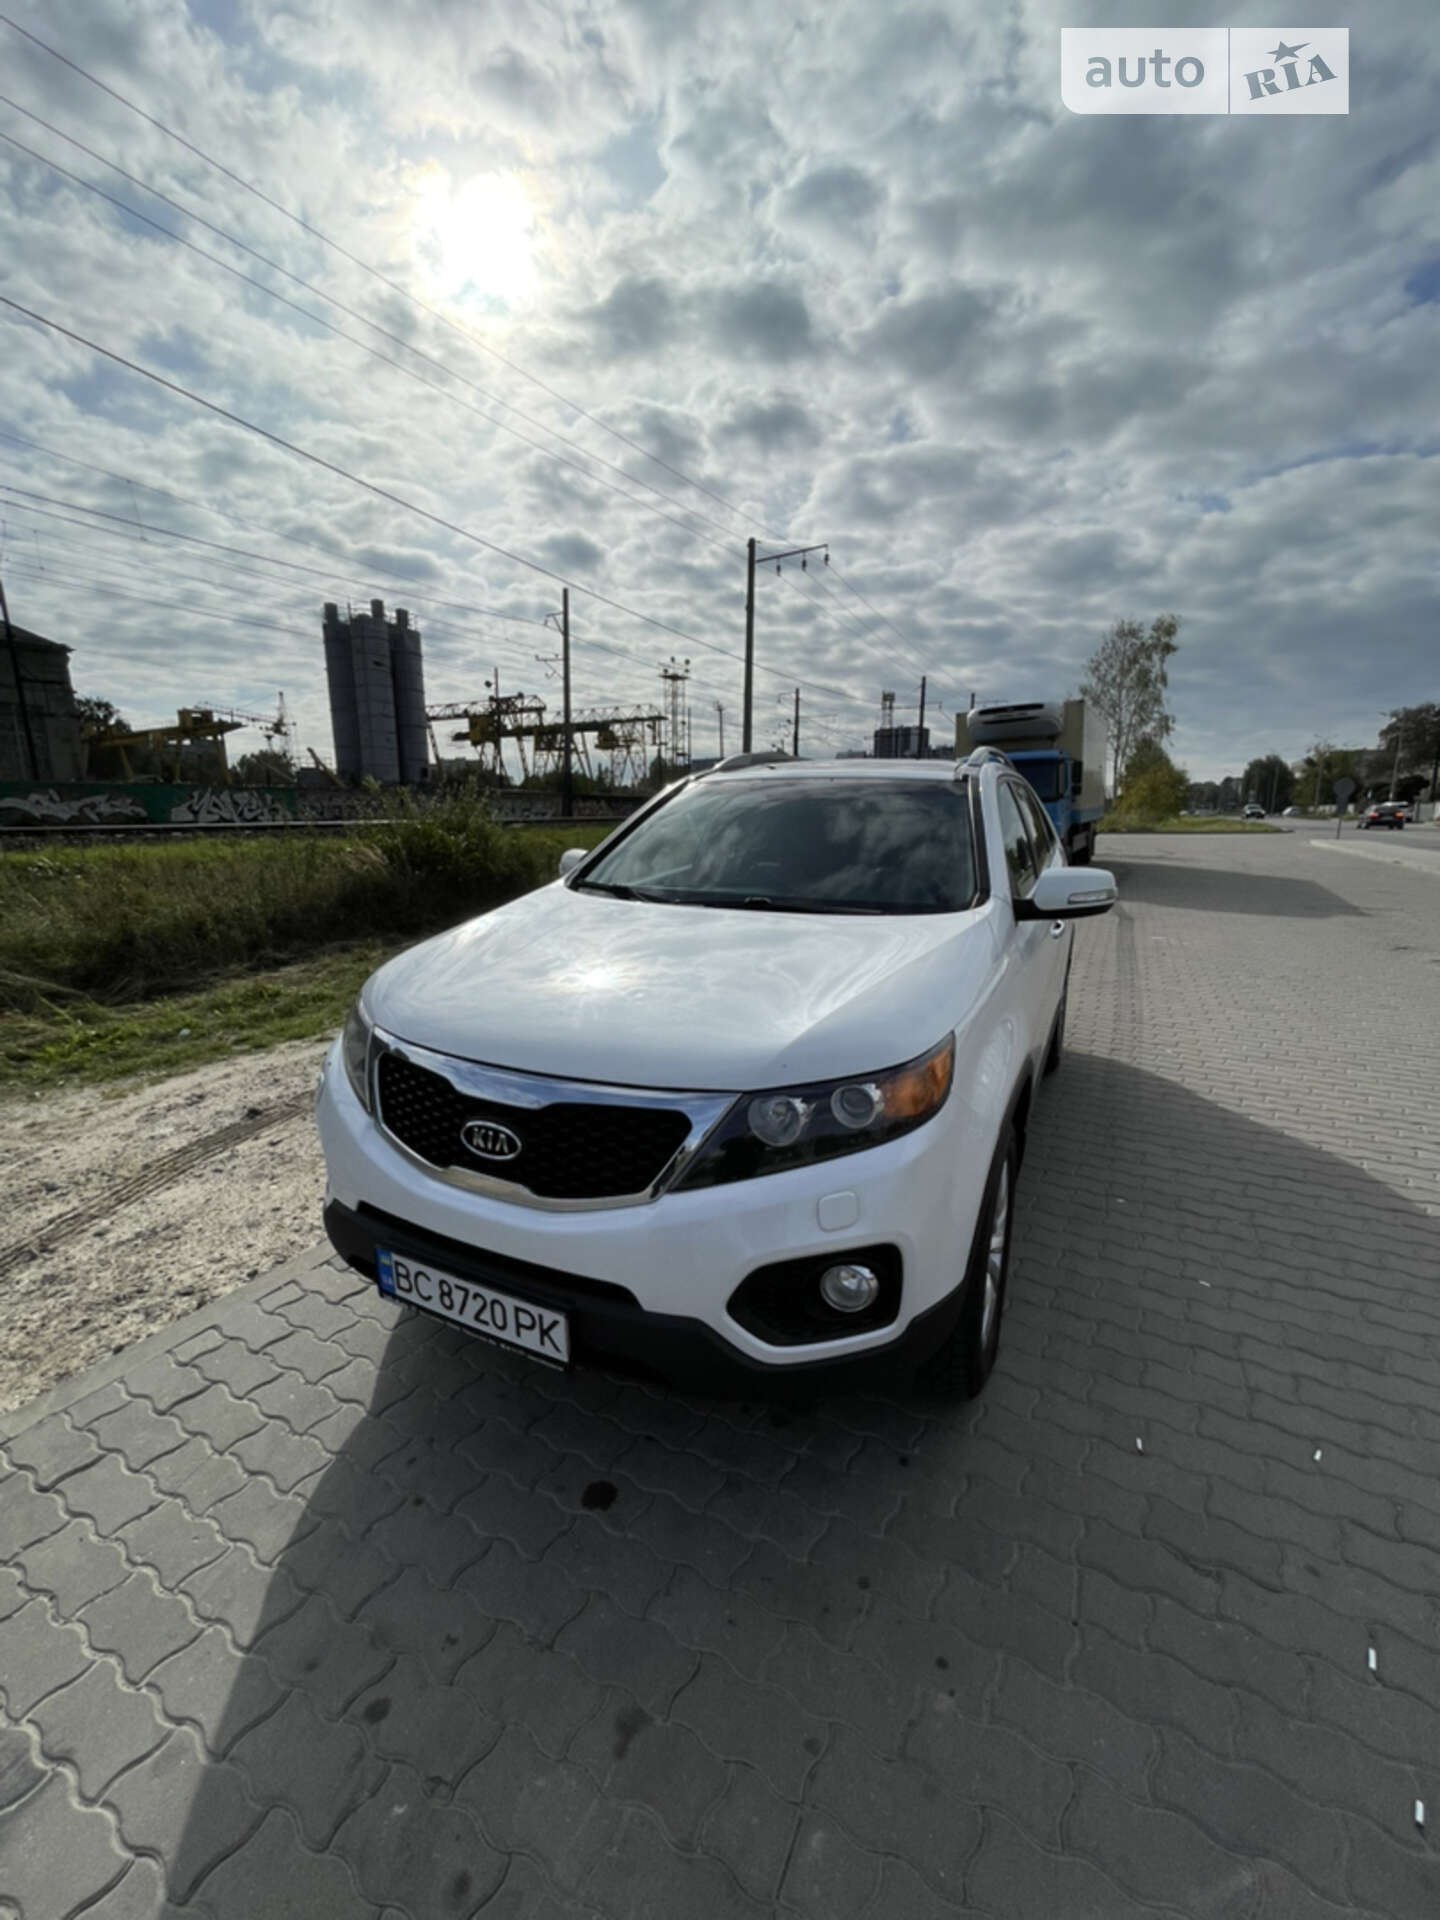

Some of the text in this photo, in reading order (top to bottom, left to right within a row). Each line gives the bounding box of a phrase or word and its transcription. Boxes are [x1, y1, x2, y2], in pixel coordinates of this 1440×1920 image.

[472, 1127, 509, 1153] KIA
[394, 1261, 562, 1353] BC 8720 PK
